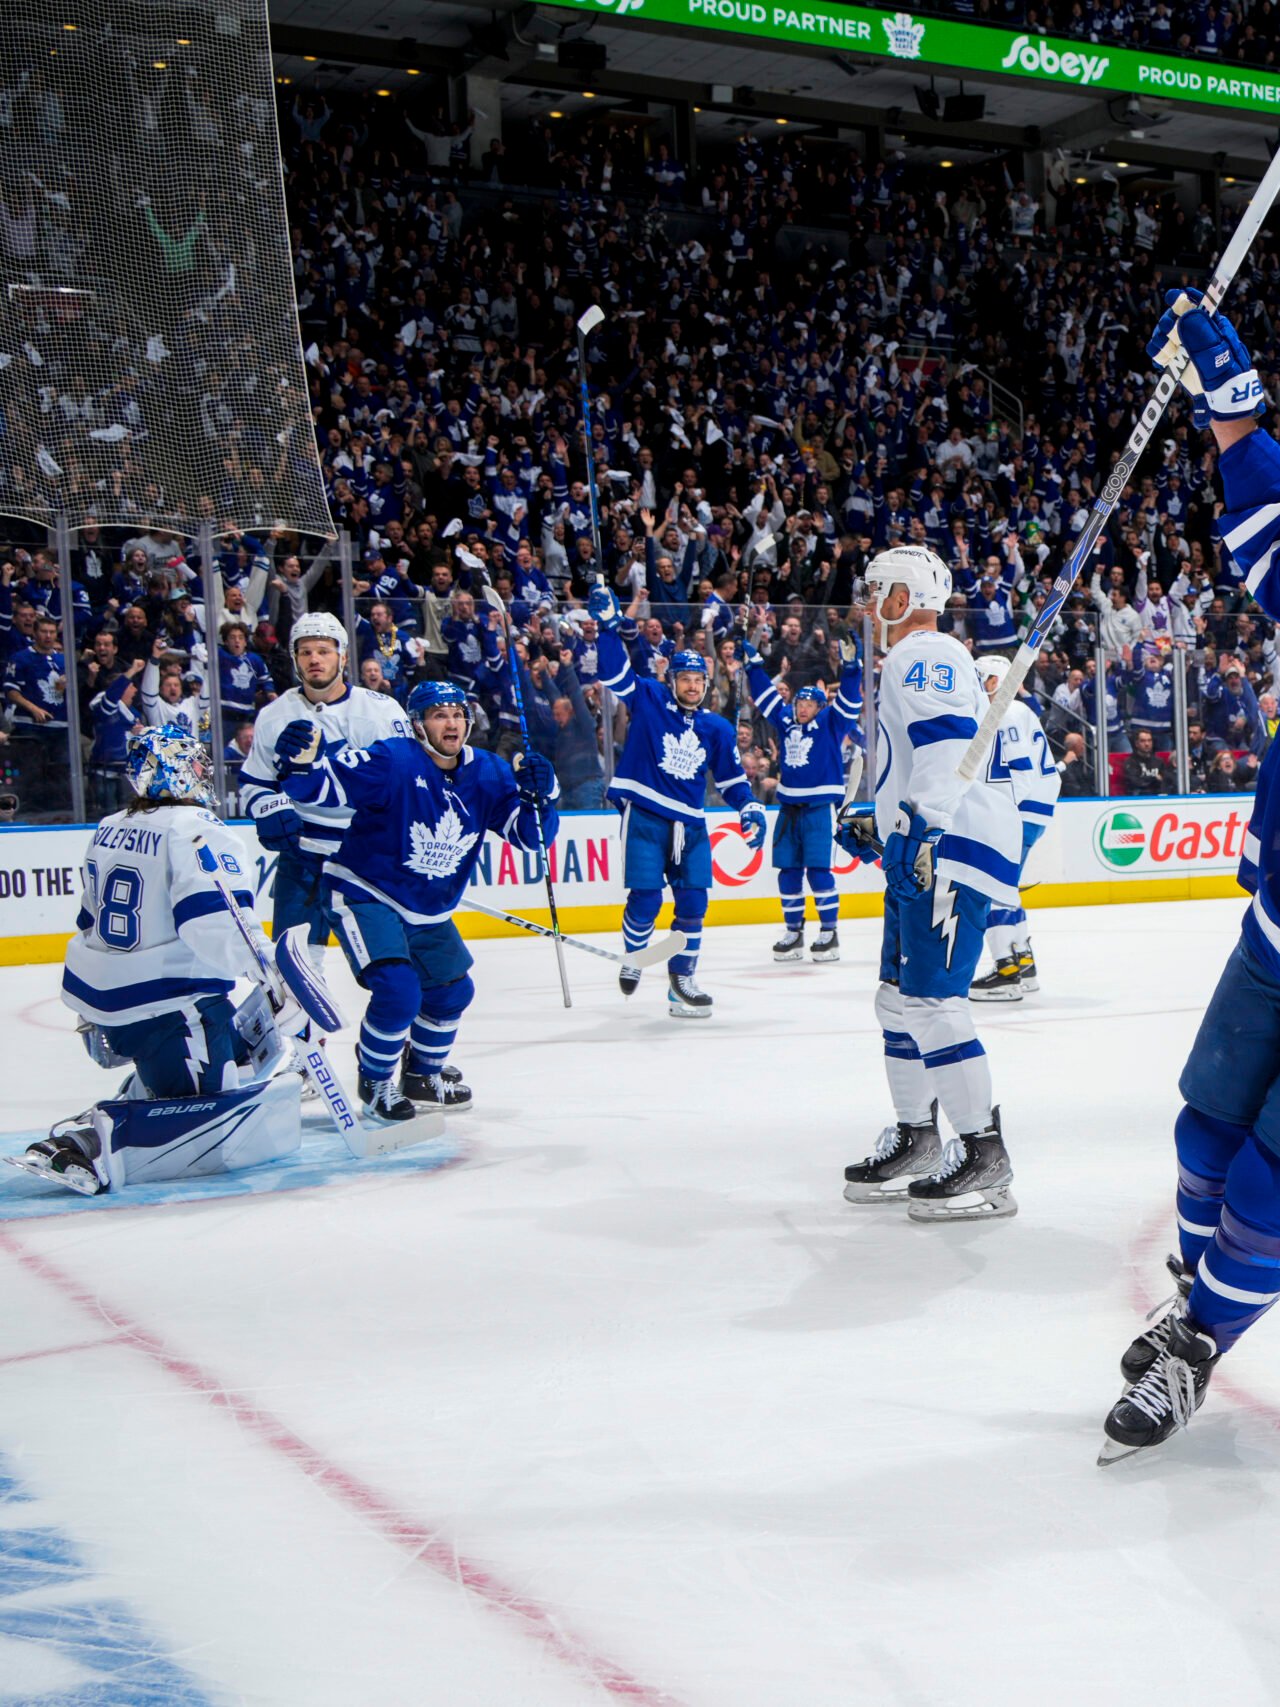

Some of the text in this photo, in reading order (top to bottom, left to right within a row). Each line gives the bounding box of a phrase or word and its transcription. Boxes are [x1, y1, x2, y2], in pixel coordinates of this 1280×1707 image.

[689, 0, 767, 23] PROUD
[773, 7, 871, 40] PARTNER
[1001, 34, 1110, 84] Sobeys
[1138, 65, 1202, 90] PROUD
[378, 575, 398, 590] 90
[902, 659, 956, 693] 43
[1032, 728, 1059, 777] 2
[259, 797, 295, 815] BAU
[420, 841, 463, 856] TORONTO
[1148, 811, 1250, 864] Cast
[420, 856, 452, 868] LEAFS
[424, 849, 455, 861] MAPLE
[470, 837, 610, 887] NADIAN
[32, 866, 75, 897] THE
[307, 1051, 354, 1132] BAUER
[147, 1101, 217, 1118] BAUER
